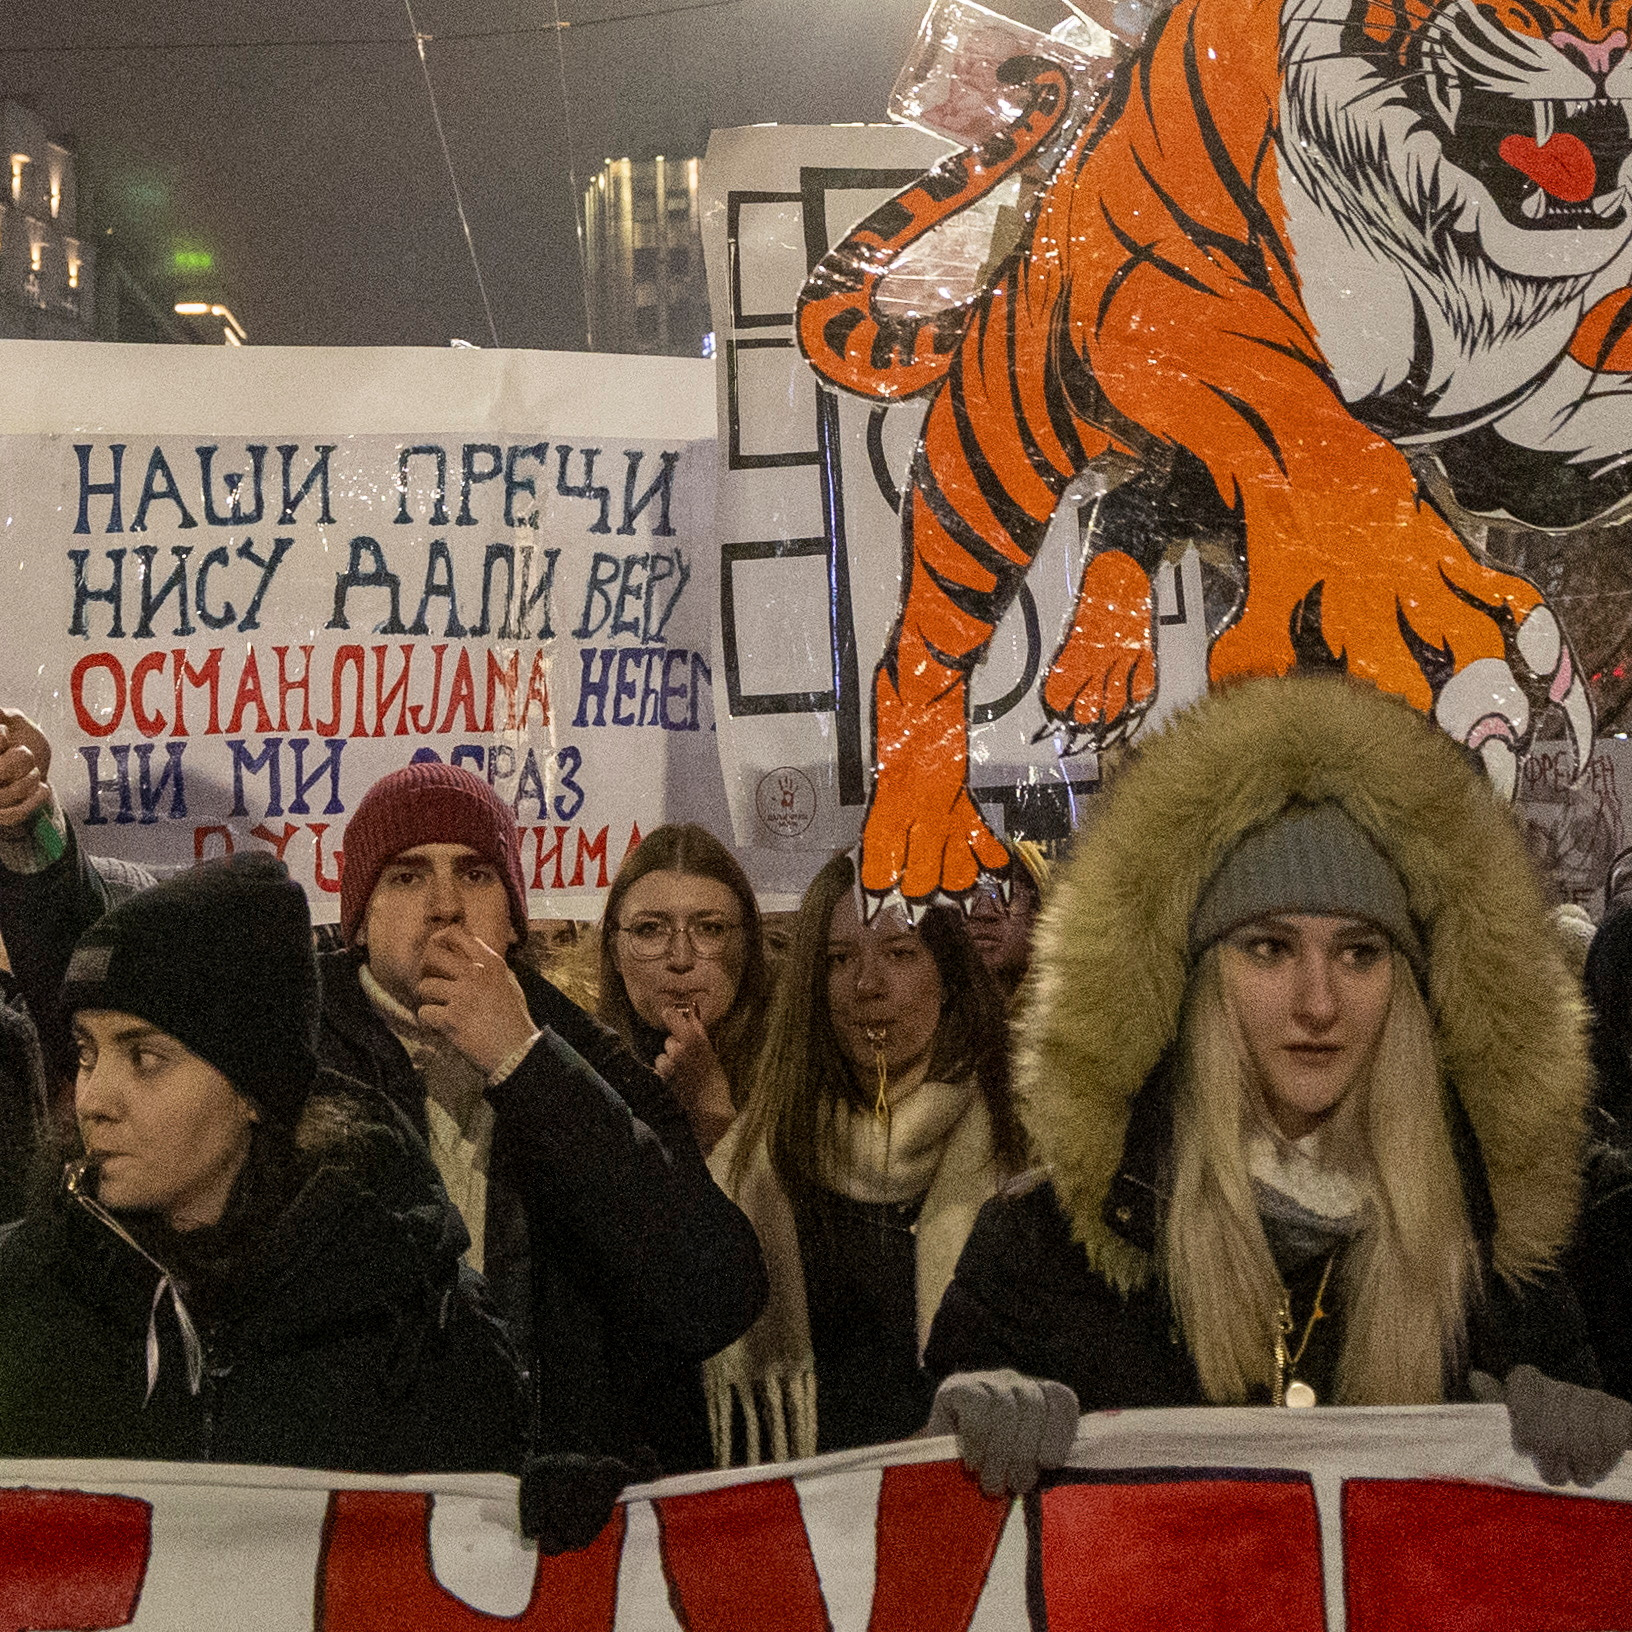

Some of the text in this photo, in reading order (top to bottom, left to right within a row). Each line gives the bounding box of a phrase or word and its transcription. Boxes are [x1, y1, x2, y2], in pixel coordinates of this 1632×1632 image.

[71, 443, 337, 535] НАШИ
[68, 535, 693, 644] НИСУ ДАЛИ ВЕРУ
[69, 643, 552, 738] ОСМАНЛИЈАМА
[78, 740, 189, 825] НИ
[225, 737, 349, 819] МИ
